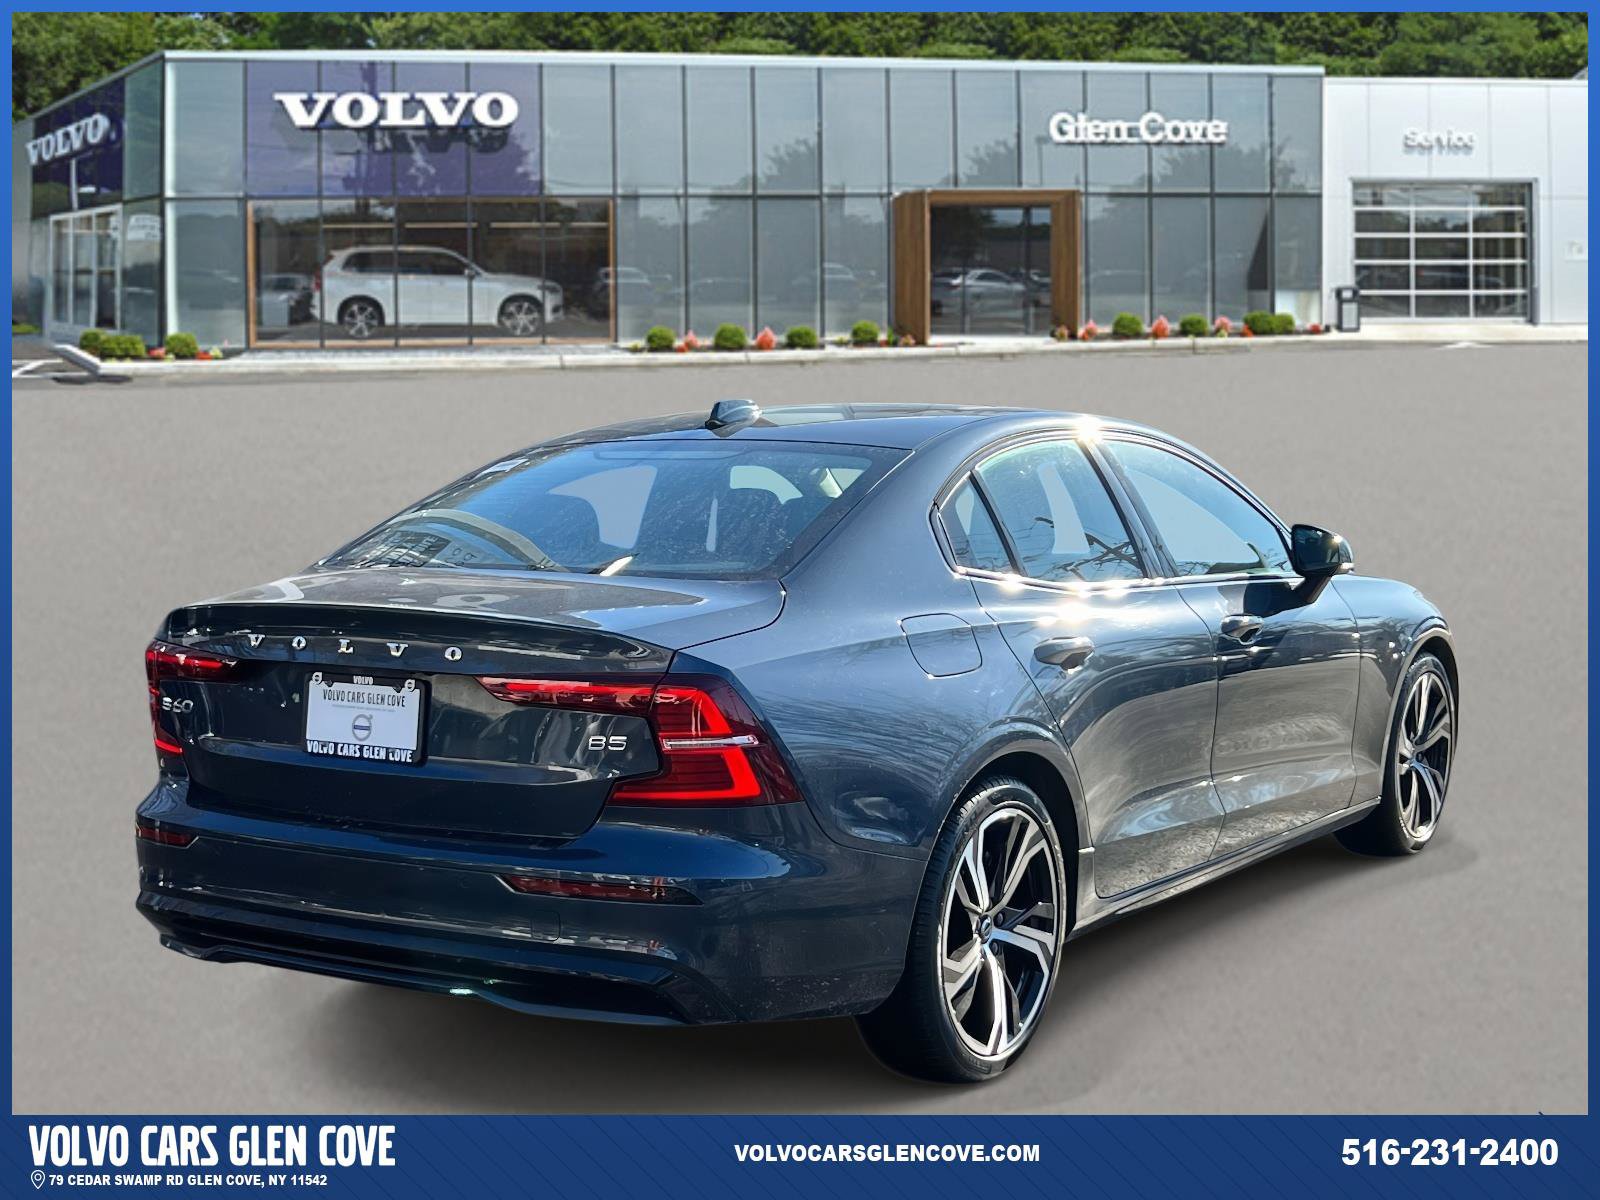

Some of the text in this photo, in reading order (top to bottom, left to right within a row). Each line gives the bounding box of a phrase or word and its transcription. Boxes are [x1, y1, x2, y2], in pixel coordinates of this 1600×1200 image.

[274, 92, 519, 128] VOLVO
[1049, 111, 1228, 144] Glen Cove
[25, 112, 110, 165] VOLVO
[1402, 127, 1475, 151] Service
[248, 633, 463, 662] VOLVO
[353, 675, 374, 685] VOLVO
[162, 697, 194, 713] S60
[323, 689, 346, 702] VOLVO
[347, 690, 366, 704] CARS
[367, 692, 386, 706] GLEN
[387, 694, 406, 708] COVE
[337, 742, 361, 758] CARS
[362, 744, 387, 760] GLEN
[588, 736, 627, 751] B5
